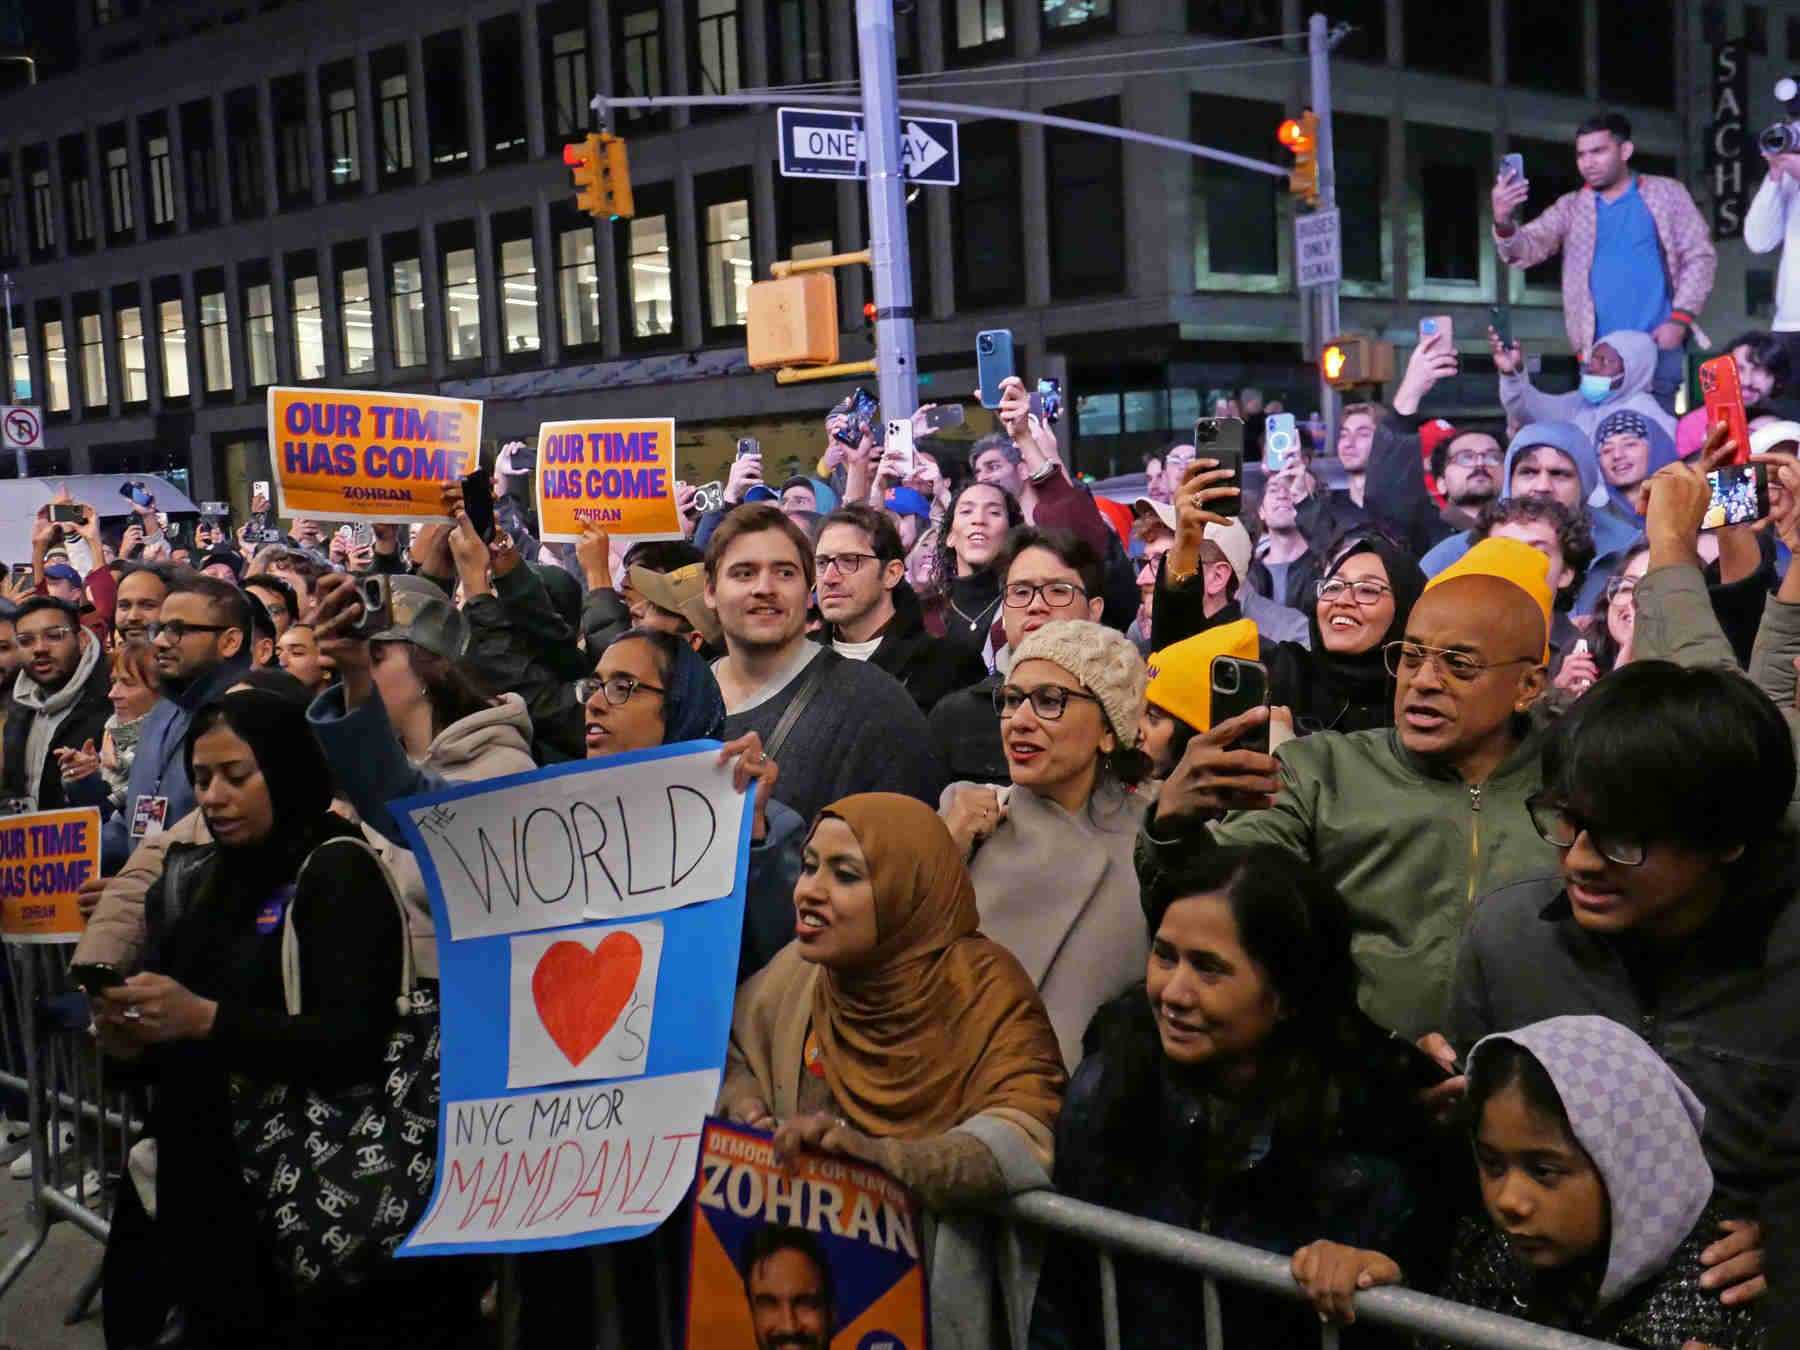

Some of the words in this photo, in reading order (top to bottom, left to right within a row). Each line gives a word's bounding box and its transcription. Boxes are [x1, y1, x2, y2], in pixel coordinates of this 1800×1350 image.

[808, 131, 857, 158] ONE
[902, 138, 930, 163] AY
[1715, 47, 1741, 234] SACHS
[285, 402, 362, 437] OUR
[368, 404, 463, 443] TIME
[284, 441, 358, 479] HAS
[363, 445, 470, 482] COME
[545, 433, 585, 464] OUR
[588, 431, 660, 463] TIME
[343, 485, 413, 501] ZOHRAN
[542, 469, 582, 499] HAS
[585, 467, 668, 499] COME
[29, 820, 88, 857] TIME
[417, 803, 457, 835] THE
[442, 785, 717, 914] WORLD
[29, 858, 93, 897] COME
[455, 1102, 515, 1147] NYC
[528, 1088, 624, 1141] MAYOR
[420, 1132, 702, 1234] MAMDANI
[697, 1157, 920, 1260] ZOHRAN
